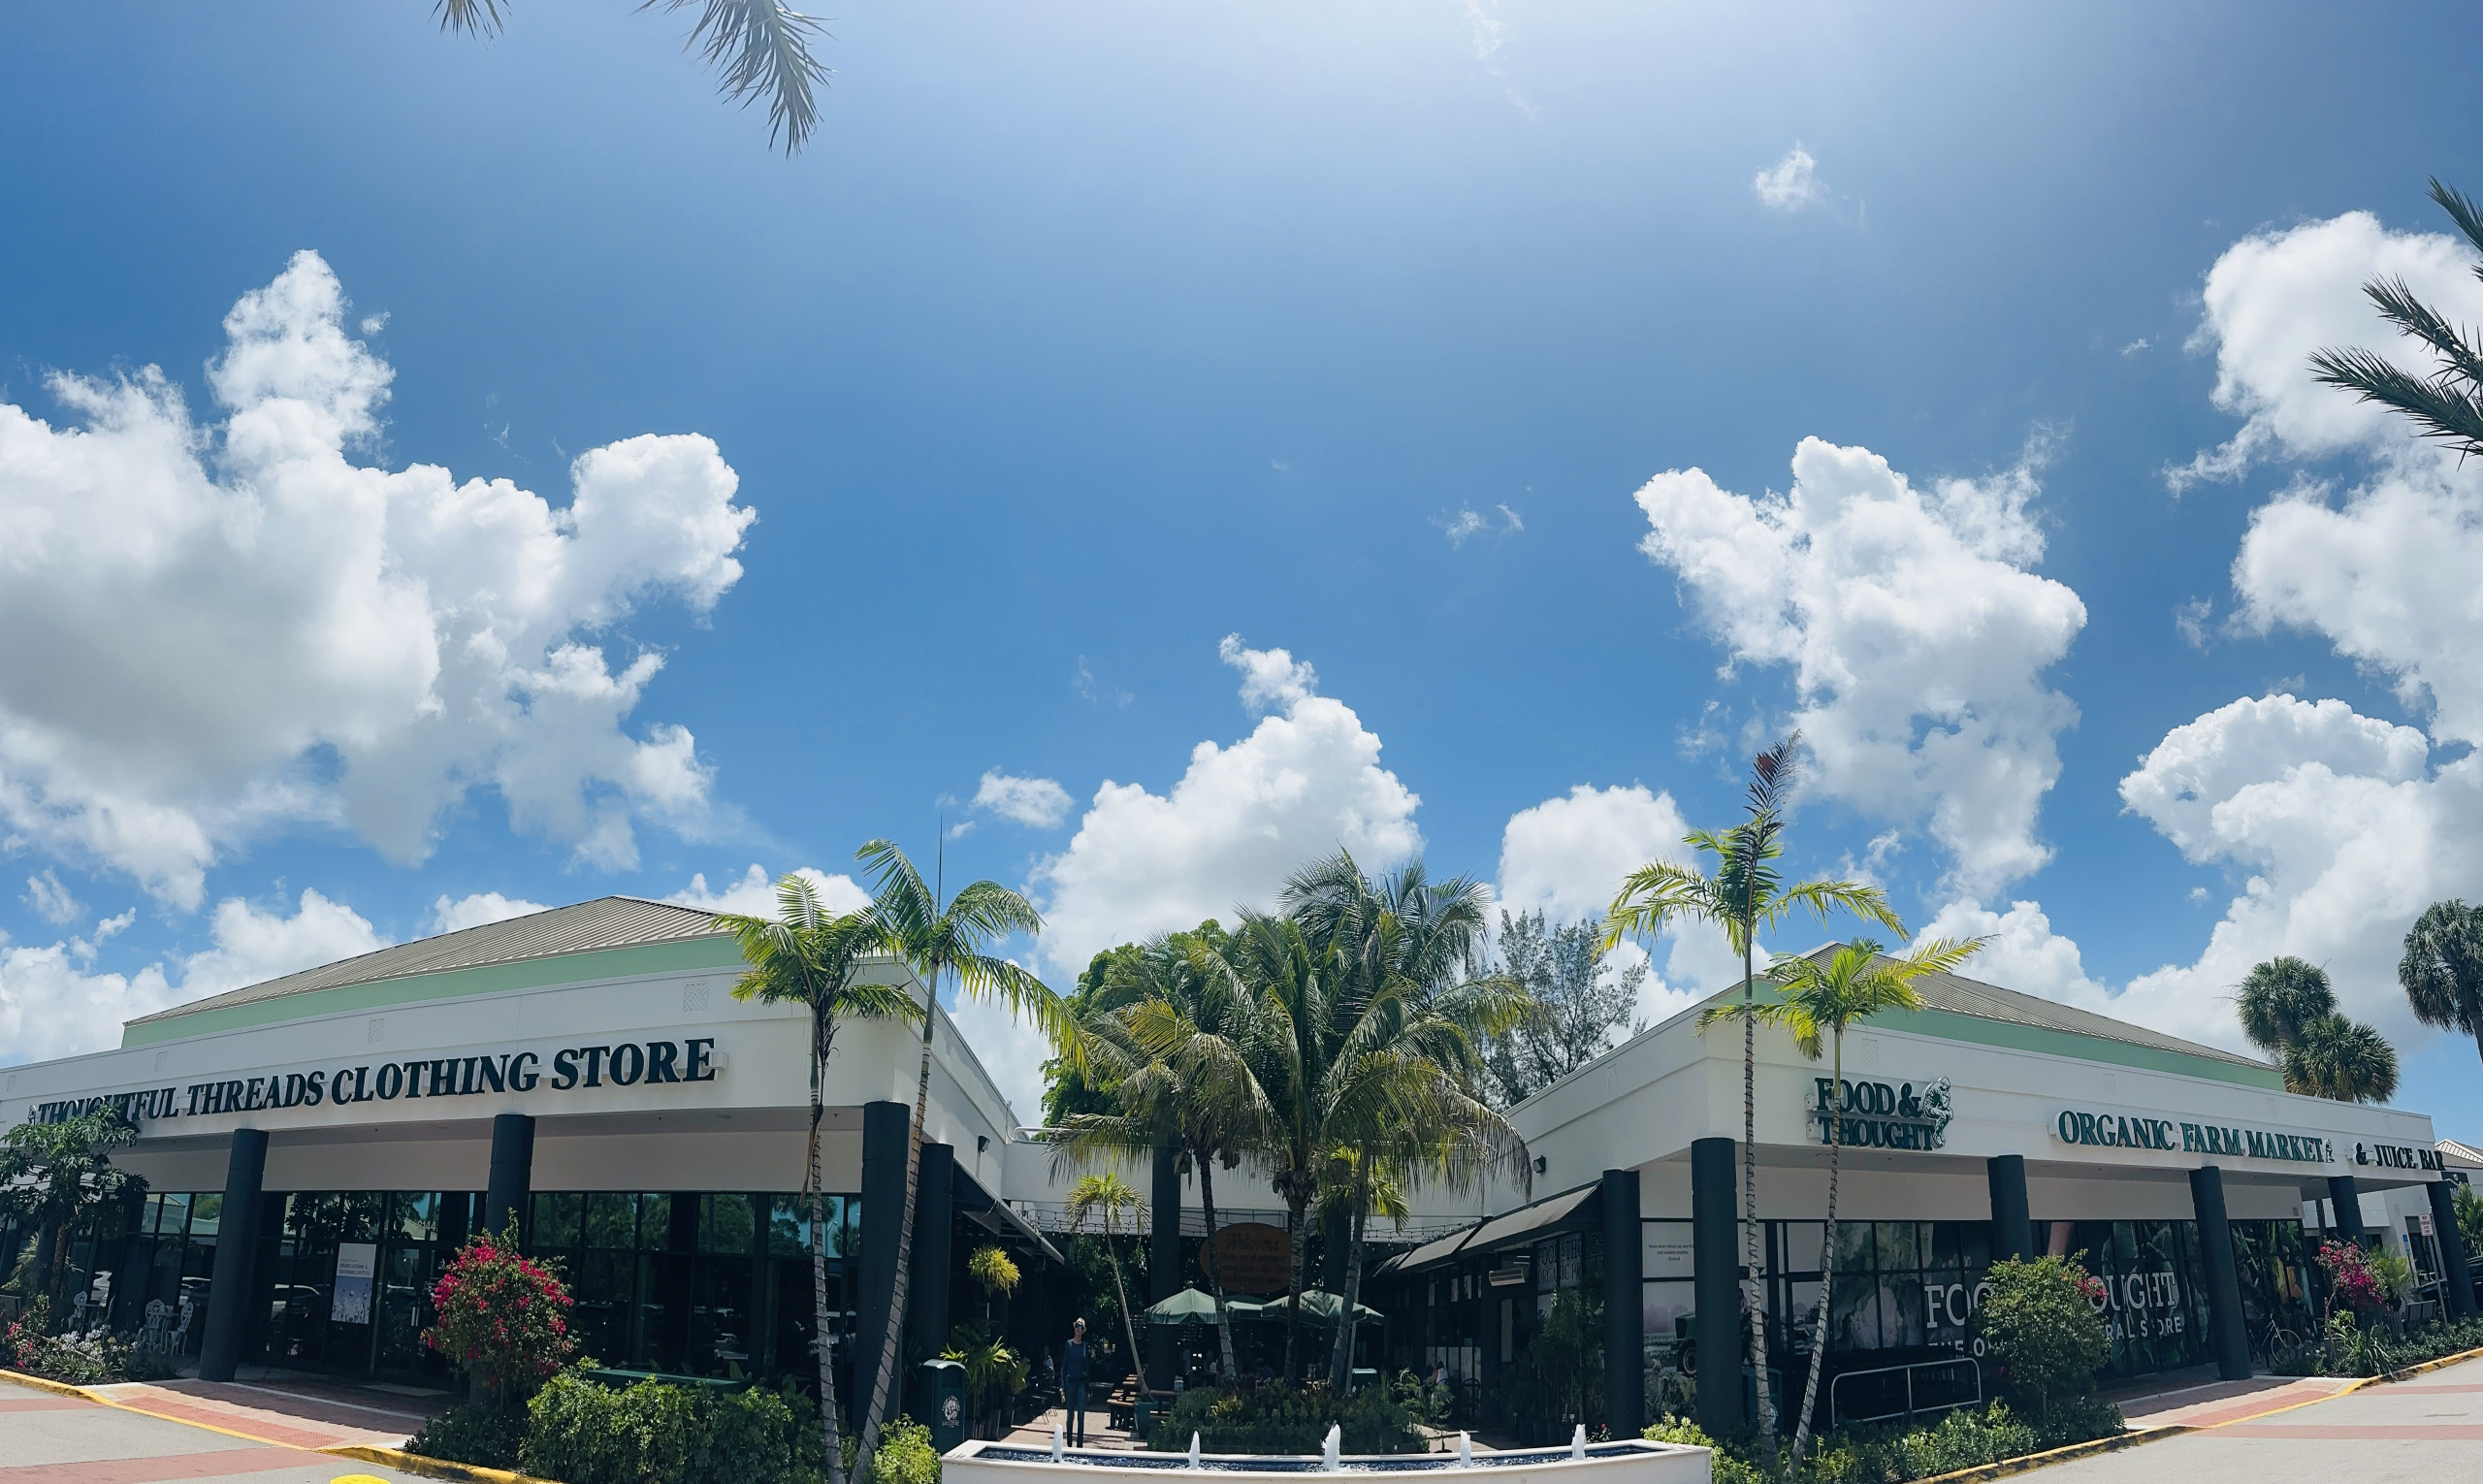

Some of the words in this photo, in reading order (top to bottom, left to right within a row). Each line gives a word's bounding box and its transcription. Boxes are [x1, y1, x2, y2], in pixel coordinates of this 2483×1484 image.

[187, 1071, 325, 1116] THREADS
[332, 1051, 539, 1105] CLOTHING
[552, 1038, 718, 1090] STORE
[1815, 1078, 1895, 1115] FOOD
[1898, 1082, 1923, 1117] &
[1818, 1116, 1934, 1151] THOUGHT
[2058, 1110, 2176, 1151] ORGANIC
[2179, 1122, 2243, 1156] FARM
[2245, 1130, 2326, 1163] MARKET
[2356, 1143, 2369, 1165] &
[2374, 1145, 2417, 1169] JUICE
[2418, 1149, 2446, 1171] BAR
[2140, 1316, 2182, 1338] SORE
